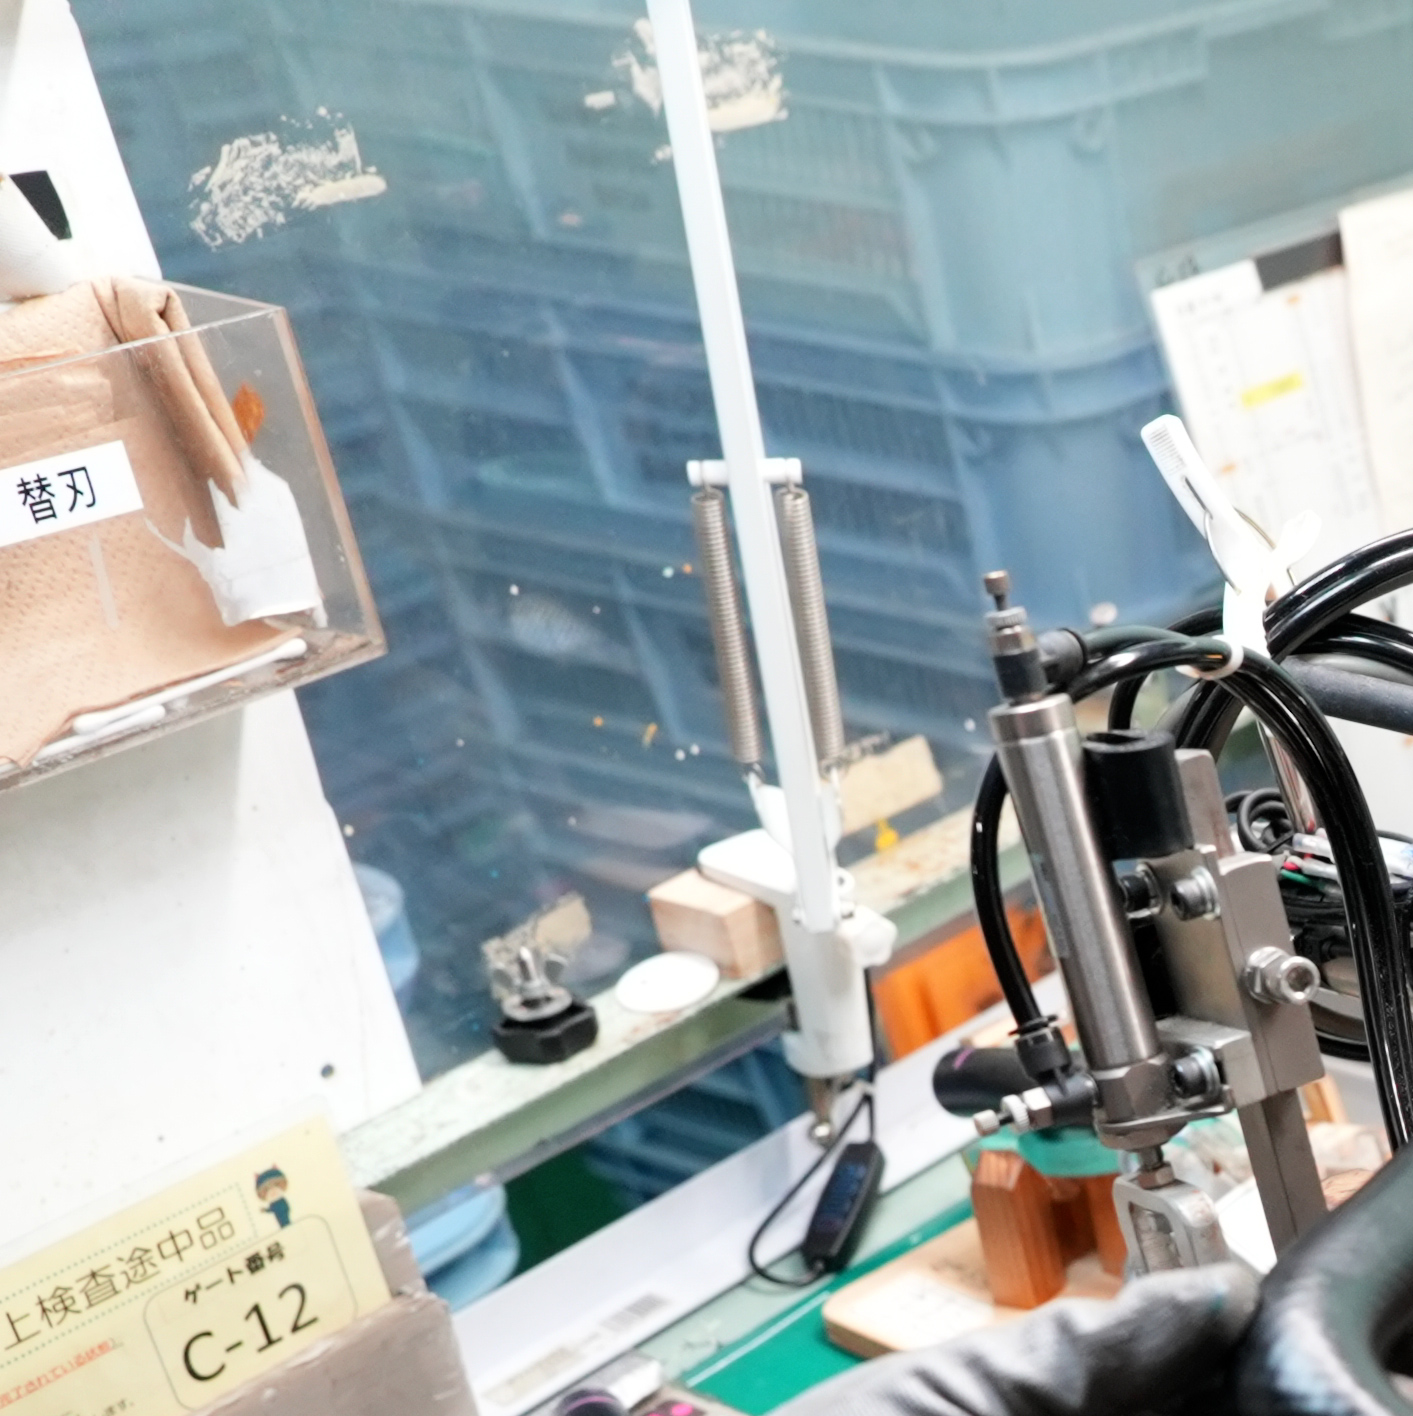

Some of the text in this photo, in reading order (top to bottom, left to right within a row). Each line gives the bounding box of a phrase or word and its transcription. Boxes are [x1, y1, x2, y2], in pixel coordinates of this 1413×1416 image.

[16, 466, 96, 524] 替刃
[5, 1206, 236, 1350] 上検査途中品
[184, 1241, 286, 1304] ゲート番号
[183, 1282, 319, 1382] C-12
